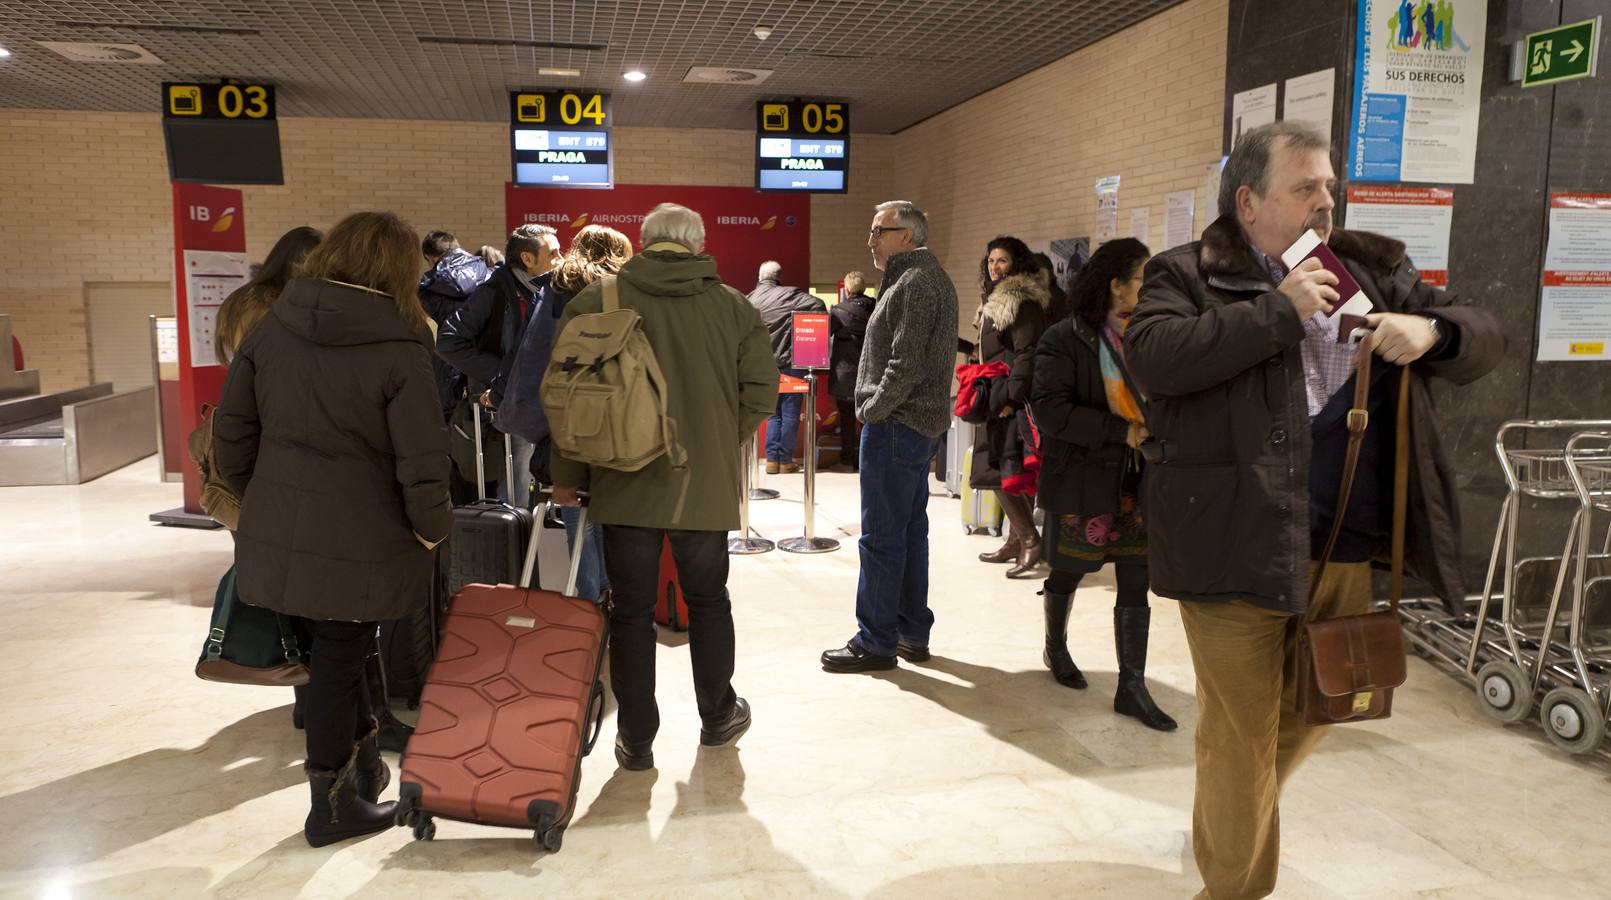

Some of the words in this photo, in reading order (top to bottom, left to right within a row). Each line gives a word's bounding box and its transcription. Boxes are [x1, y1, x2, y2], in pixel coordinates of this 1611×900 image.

[1386, 70, 1406, 80] SUS
[1409, 71, 1465, 84] DERECHOS
[218, 85, 269, 118] 03
[560, 93, 606, 125] 04
[1358, 74, 1369, 134] PASAJEROS
[802, 103, 844, 133] 05
[538, 151, 587, 163] PRAGA
[781, 158, 825, 170] PRAGA
[1355, 136, 1365, 177] AÉREOS
[189, 205, 210, 221] IB
[524, 213, 570, 222] IBERIA
[717, 216, 760, 225] IBERIA
